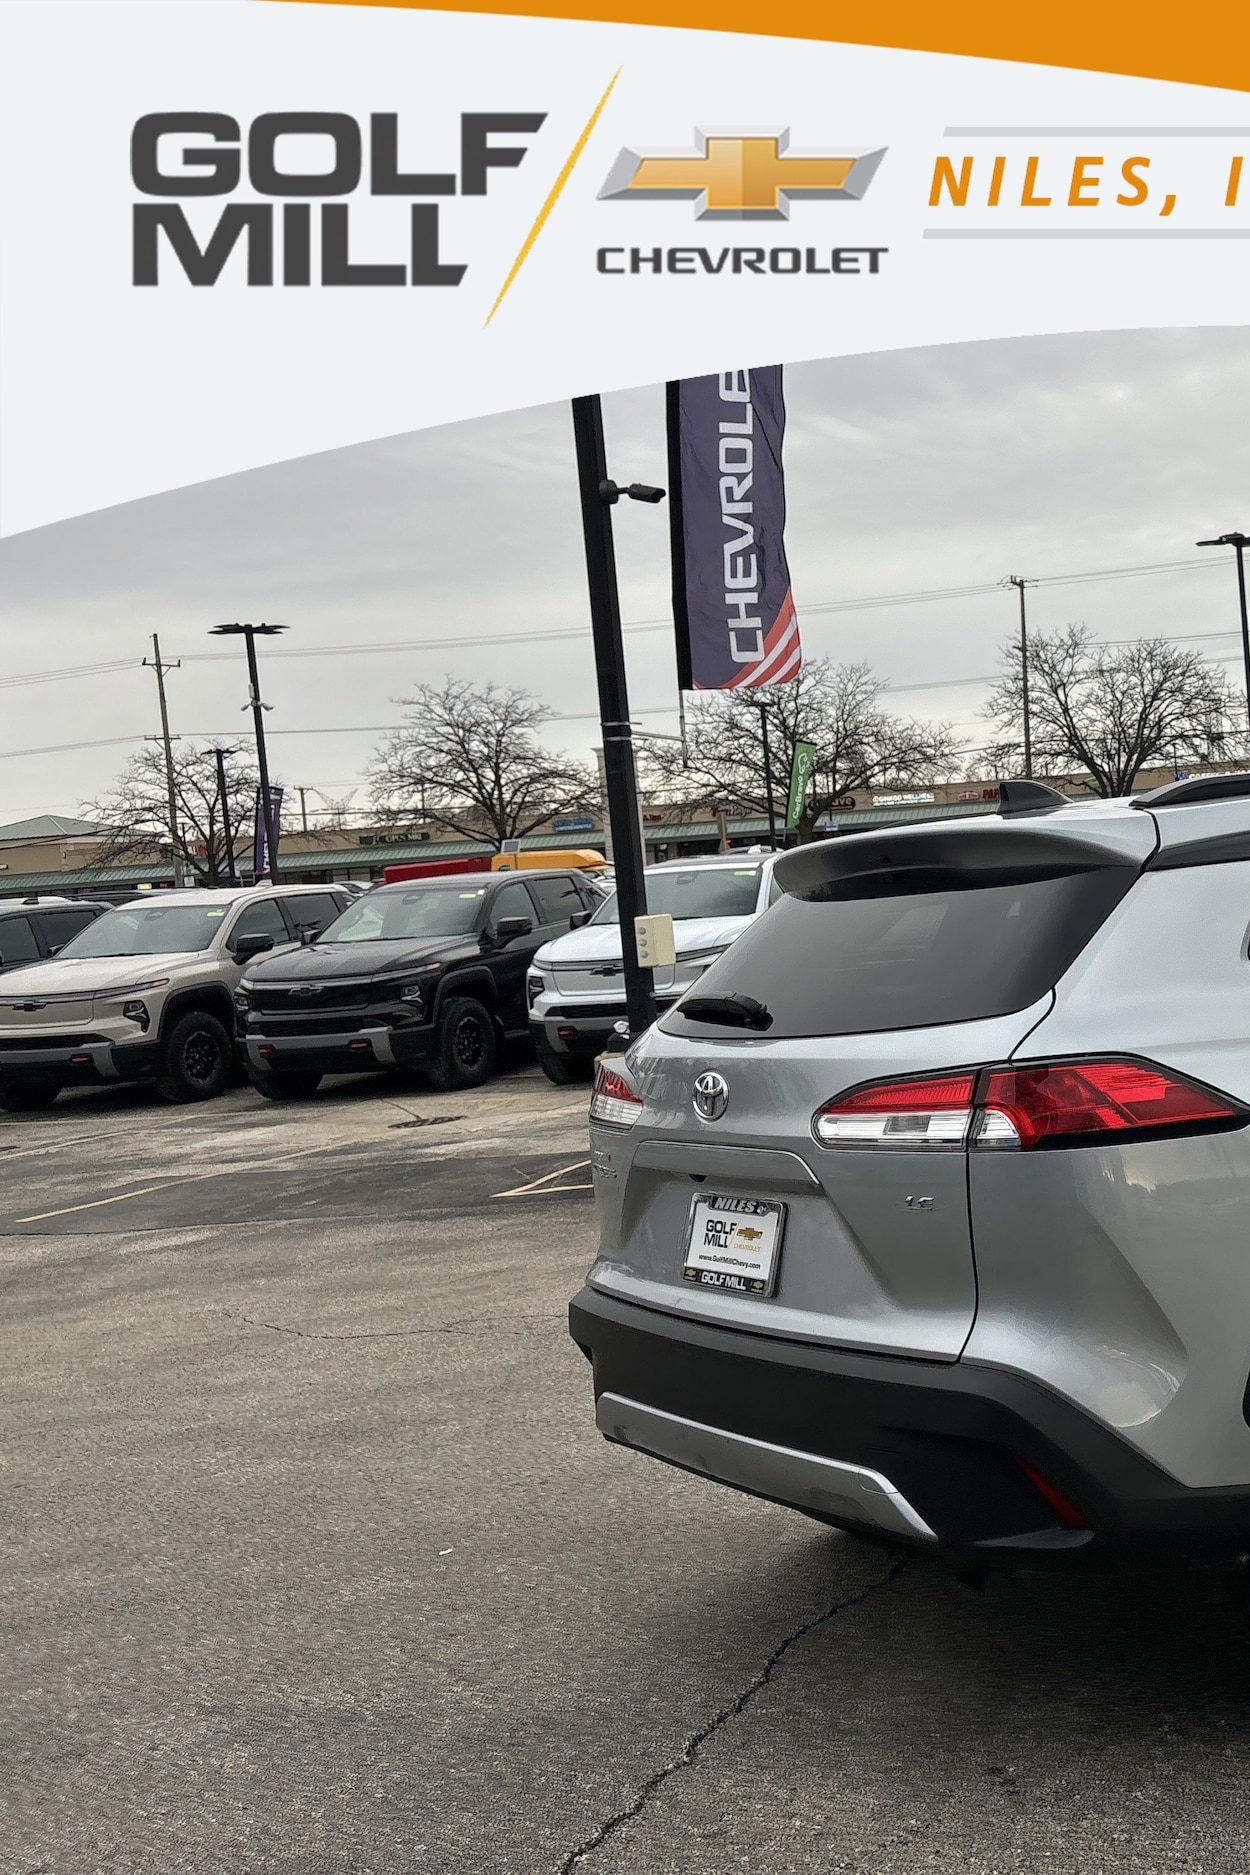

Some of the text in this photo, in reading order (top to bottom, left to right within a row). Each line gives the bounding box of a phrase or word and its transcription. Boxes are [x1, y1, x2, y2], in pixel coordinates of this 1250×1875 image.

[715, 1197, 757, 1213] NILES
[706, 1219, 738, 1236] GOLF
[703, 1233, 729, 1249] MILL
[699, 1255, 761, 1269] www.GolfMillChevy.com
[701, 1271, 726, 1286] GOLF
[726, 1277, 747, 1290] MILL
